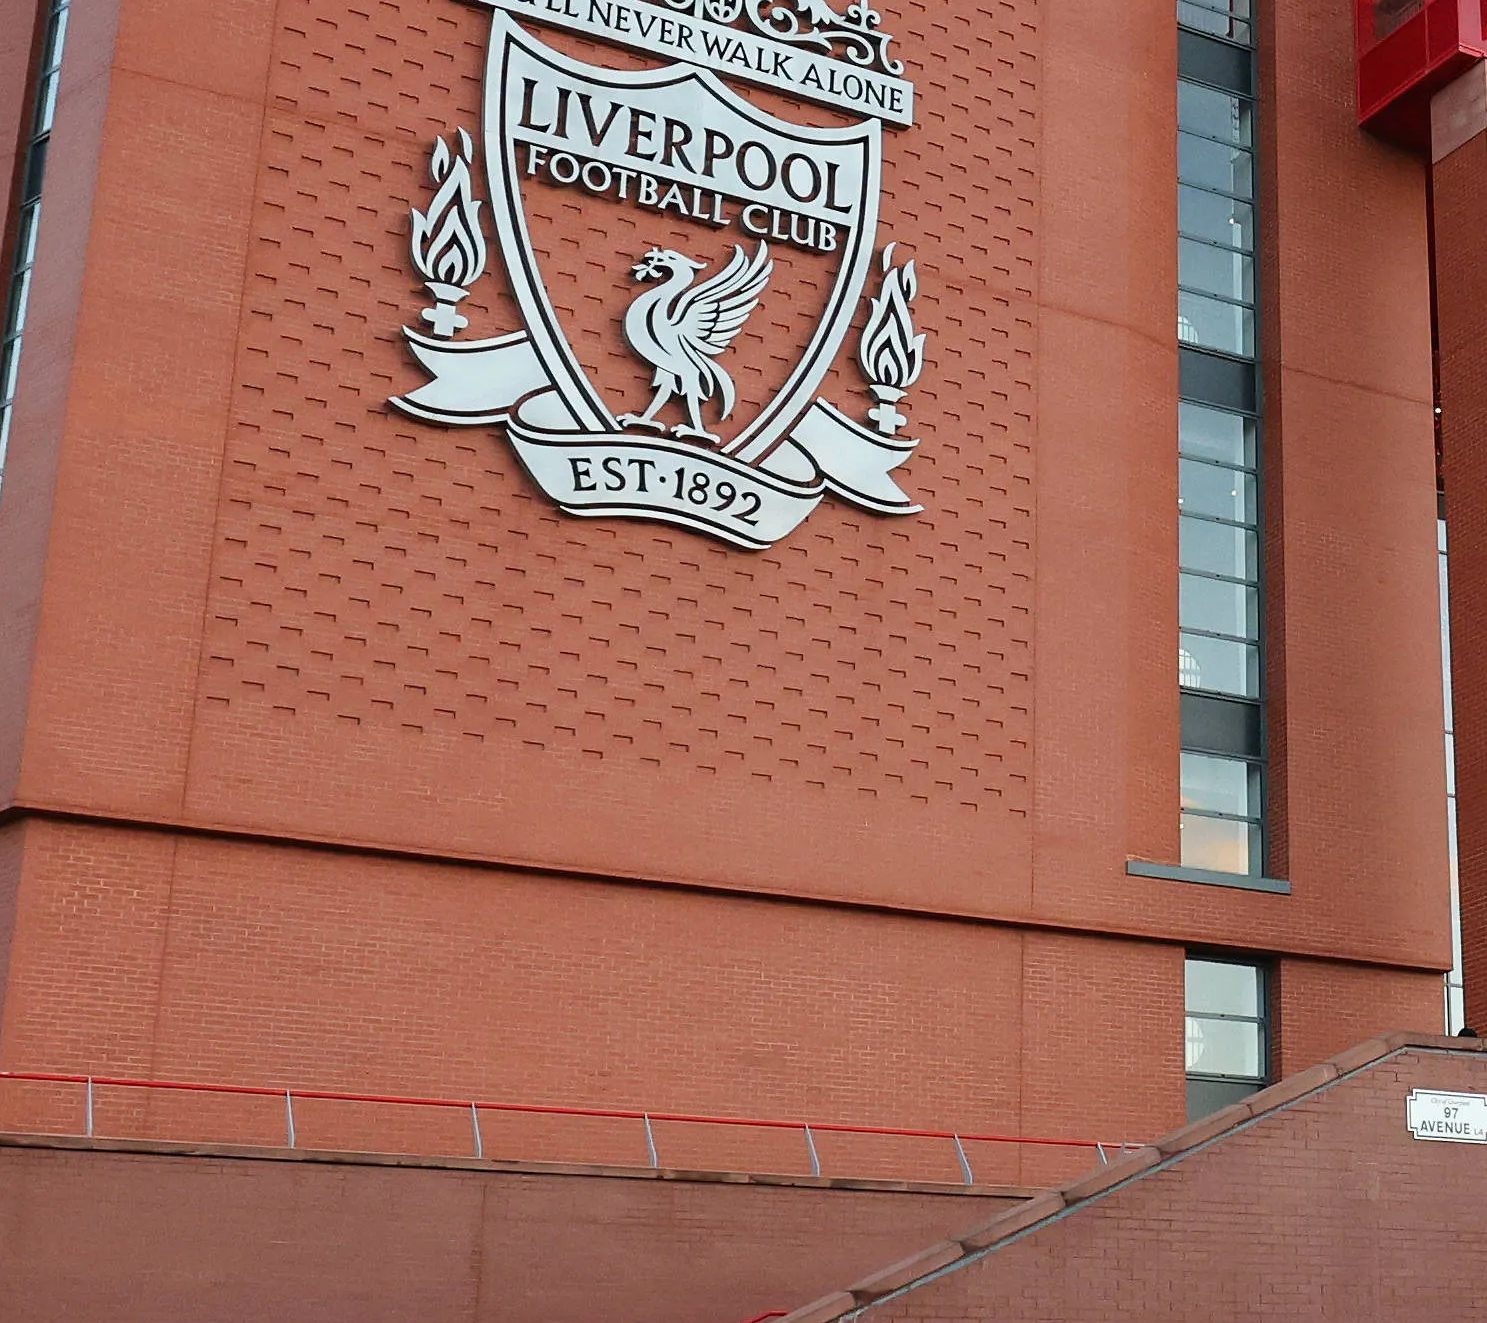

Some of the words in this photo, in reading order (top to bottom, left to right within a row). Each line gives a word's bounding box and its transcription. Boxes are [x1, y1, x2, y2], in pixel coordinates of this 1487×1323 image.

[700, 29, 795, 82] WALK
[799, 63, 904, 114] ALONE
[516, 76, 854, 215] LIVERPOOL
[527, 144, 732, 226] FOOTBALL
[741, 203, 838, 252] CLUB
[1420, 1120, 1471, 1135] AVENUE
[1443, 1106, 1459, 1119] 97
